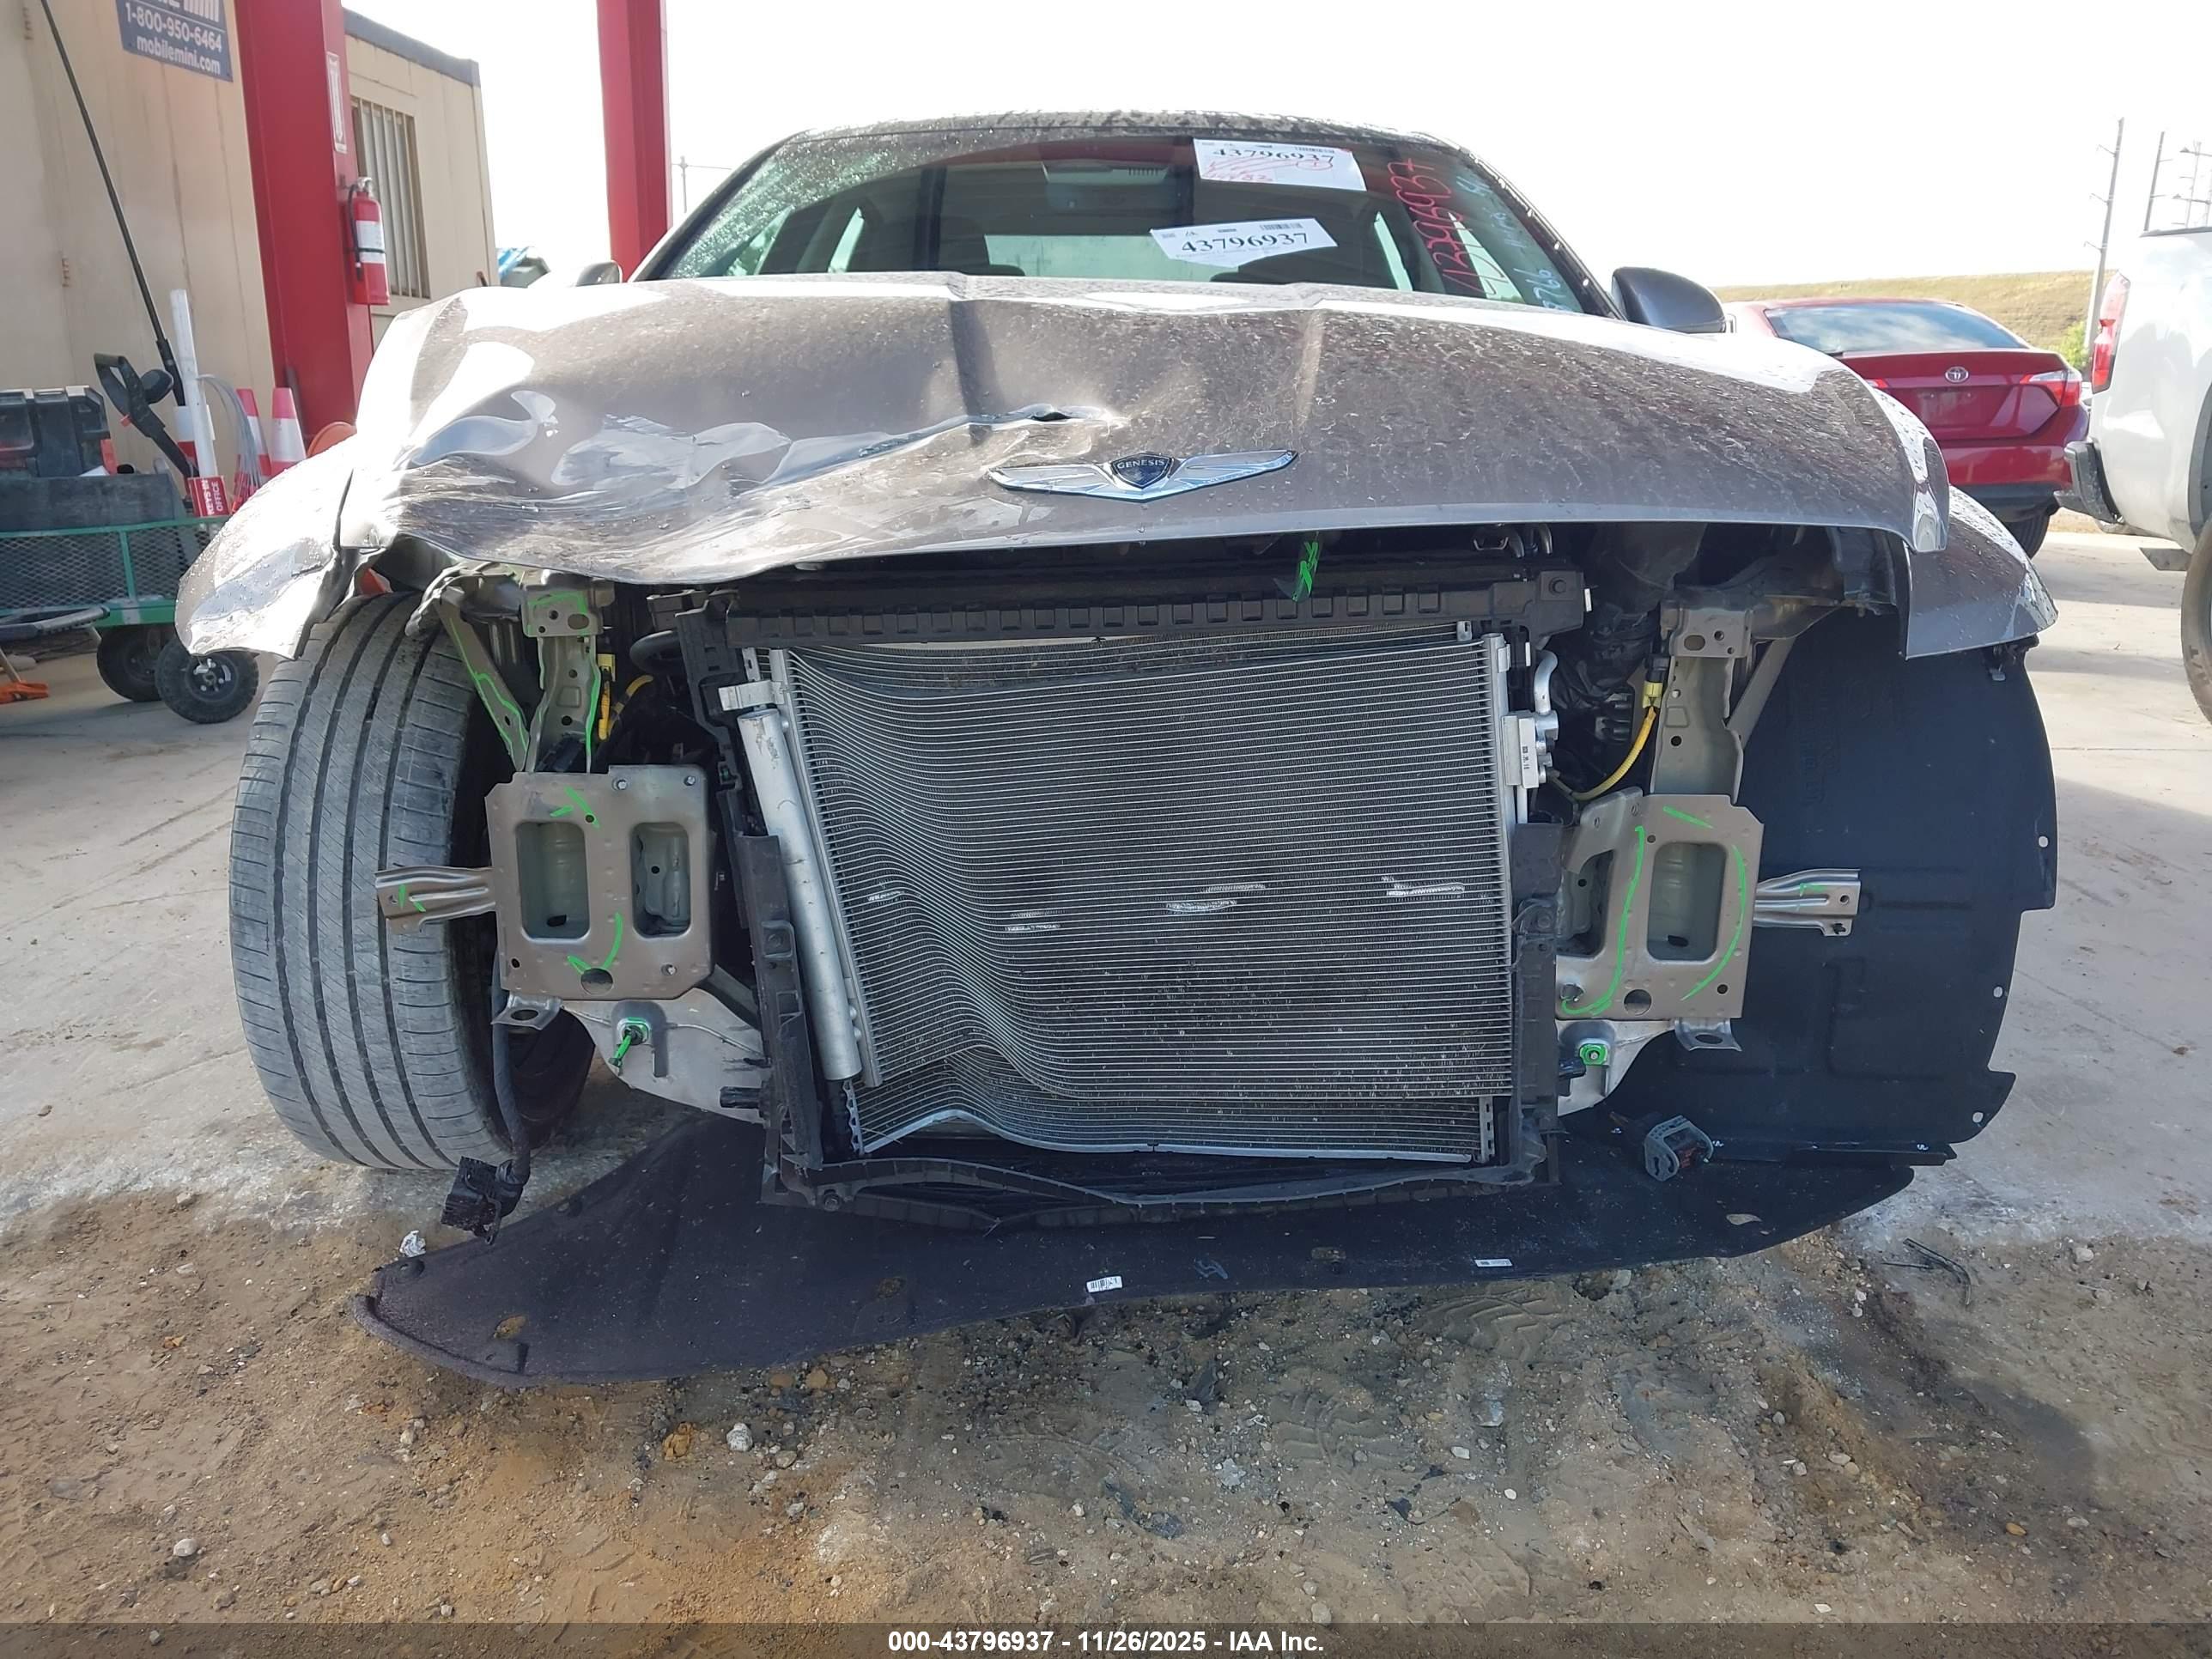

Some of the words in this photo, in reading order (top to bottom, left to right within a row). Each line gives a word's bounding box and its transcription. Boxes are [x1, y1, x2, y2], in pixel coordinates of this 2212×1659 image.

[125, 3, 222, 53] 1-800-950-6464
[137, 35, 221, 75] mobilemini.com
[1212, 148, 1334, 164] 43796937
[1182, 233, 1309, 252] 43796937
[1117, 459, 1165, 469] GENESIS
[211, 481, 223, 512] OFFICE
